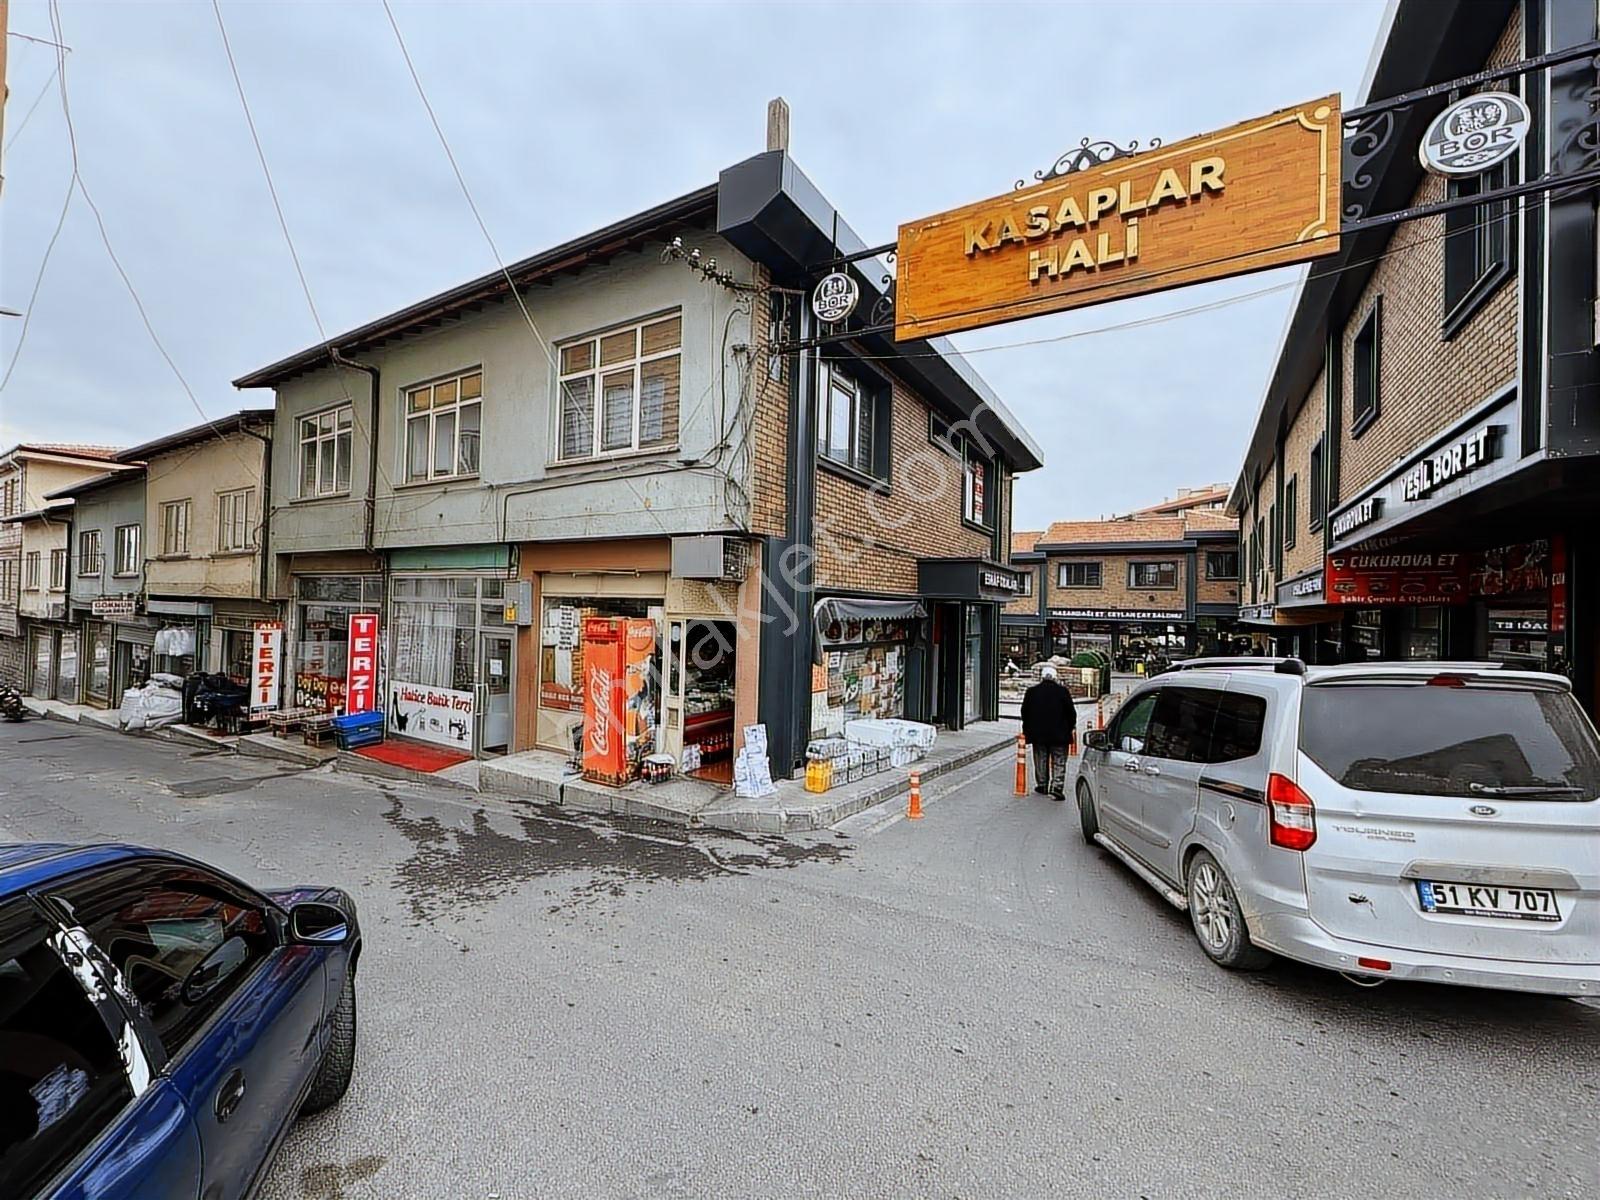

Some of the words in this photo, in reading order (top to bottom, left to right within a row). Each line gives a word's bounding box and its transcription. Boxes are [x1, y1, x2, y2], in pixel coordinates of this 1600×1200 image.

[1440, 127, 1515, 157] BOR
[964, 157, 1226, 256] KASAPLAR
[1029, 217, 1140, 281] HALİ
[818, 295, 849, 310] BOR
[1400, 460, 1431, 501] YEŞİL
[1433, 442, 1463, 485] BOR
[1465, 427, 1488, 466] ET
[1363, 498, 1374, 522] ET
[1437, 554, 1460, 566] ET
[258, 632, 275, 704] TERZİ
[352, 618, 373, 709] TERZİ
[1432, 885, 1459, 905] 51
[1468, 887, 1499, 908] KV
[1508, 890, 1549, 912] 707
